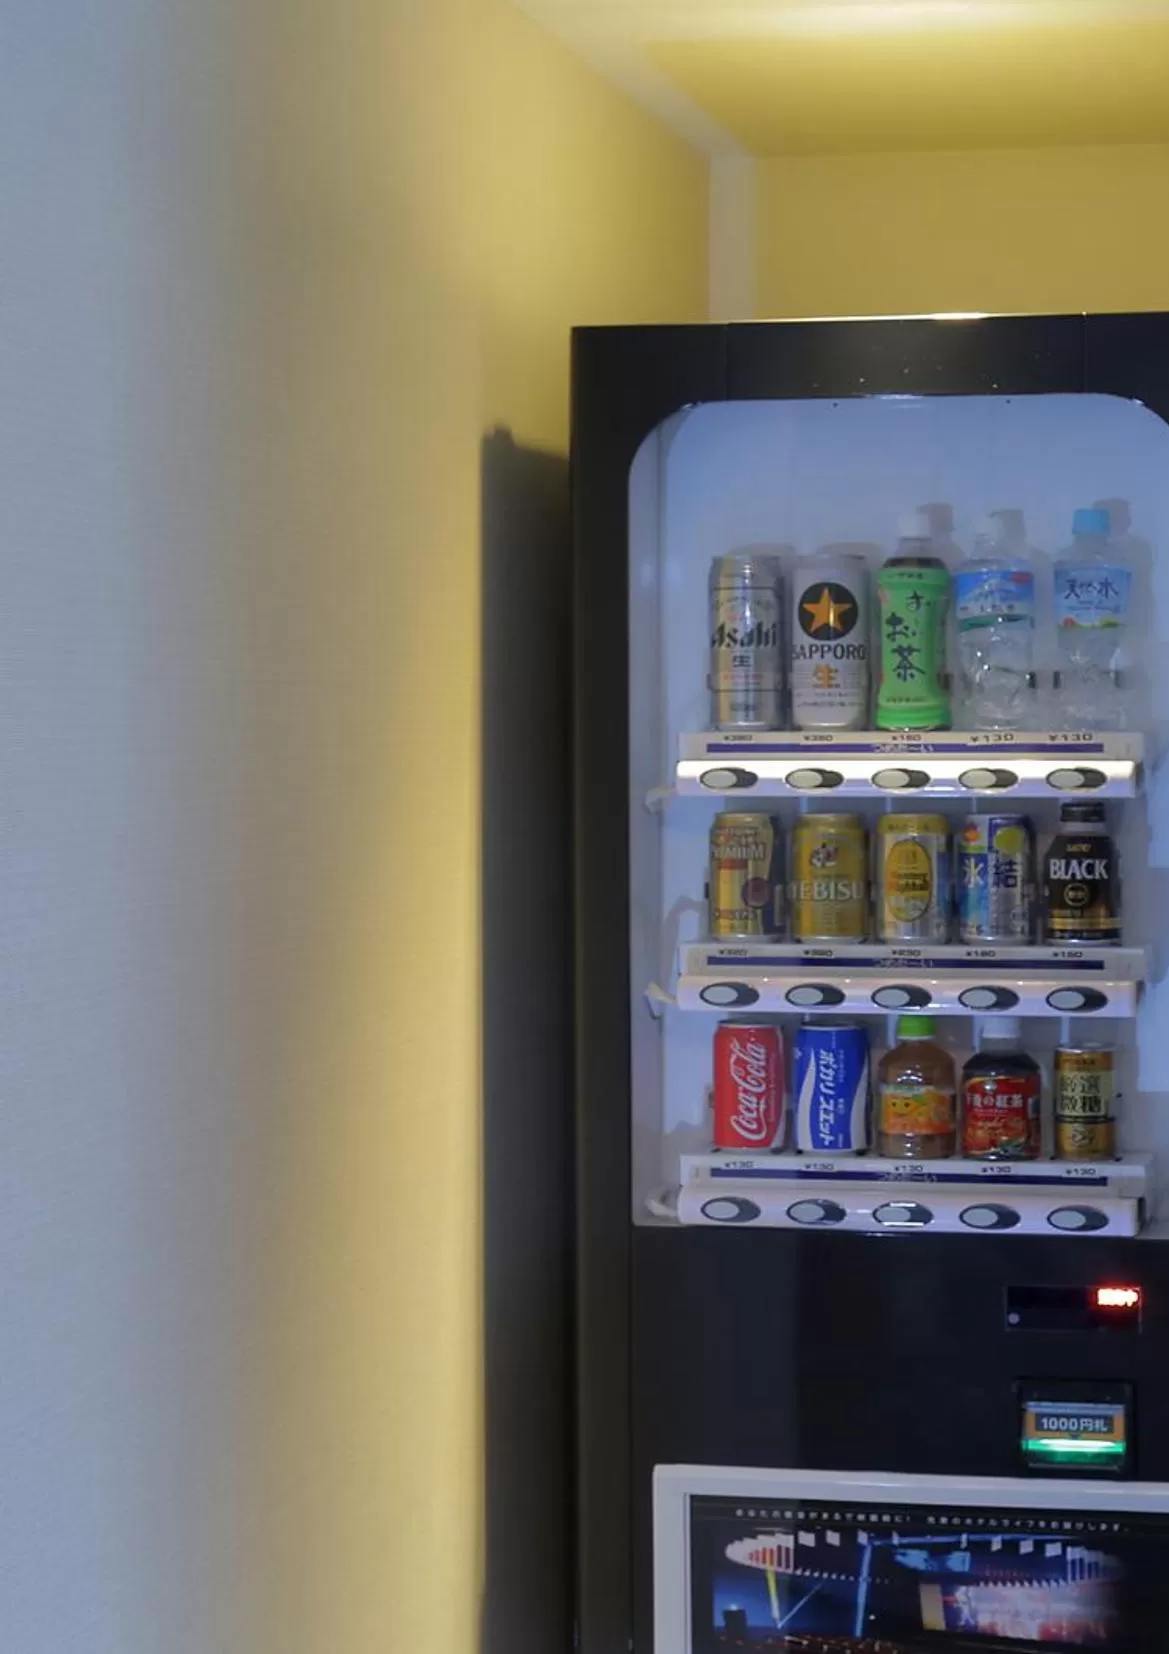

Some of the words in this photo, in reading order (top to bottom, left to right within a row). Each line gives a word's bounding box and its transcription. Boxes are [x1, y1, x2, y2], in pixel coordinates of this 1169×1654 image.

[711, 620, 777, 649] Asahi
[791, 643, 867, 661] SAPPORO
[1048, 732, 1093, 743] ¥130
[1049, 858, 1109, 880] BLACK
